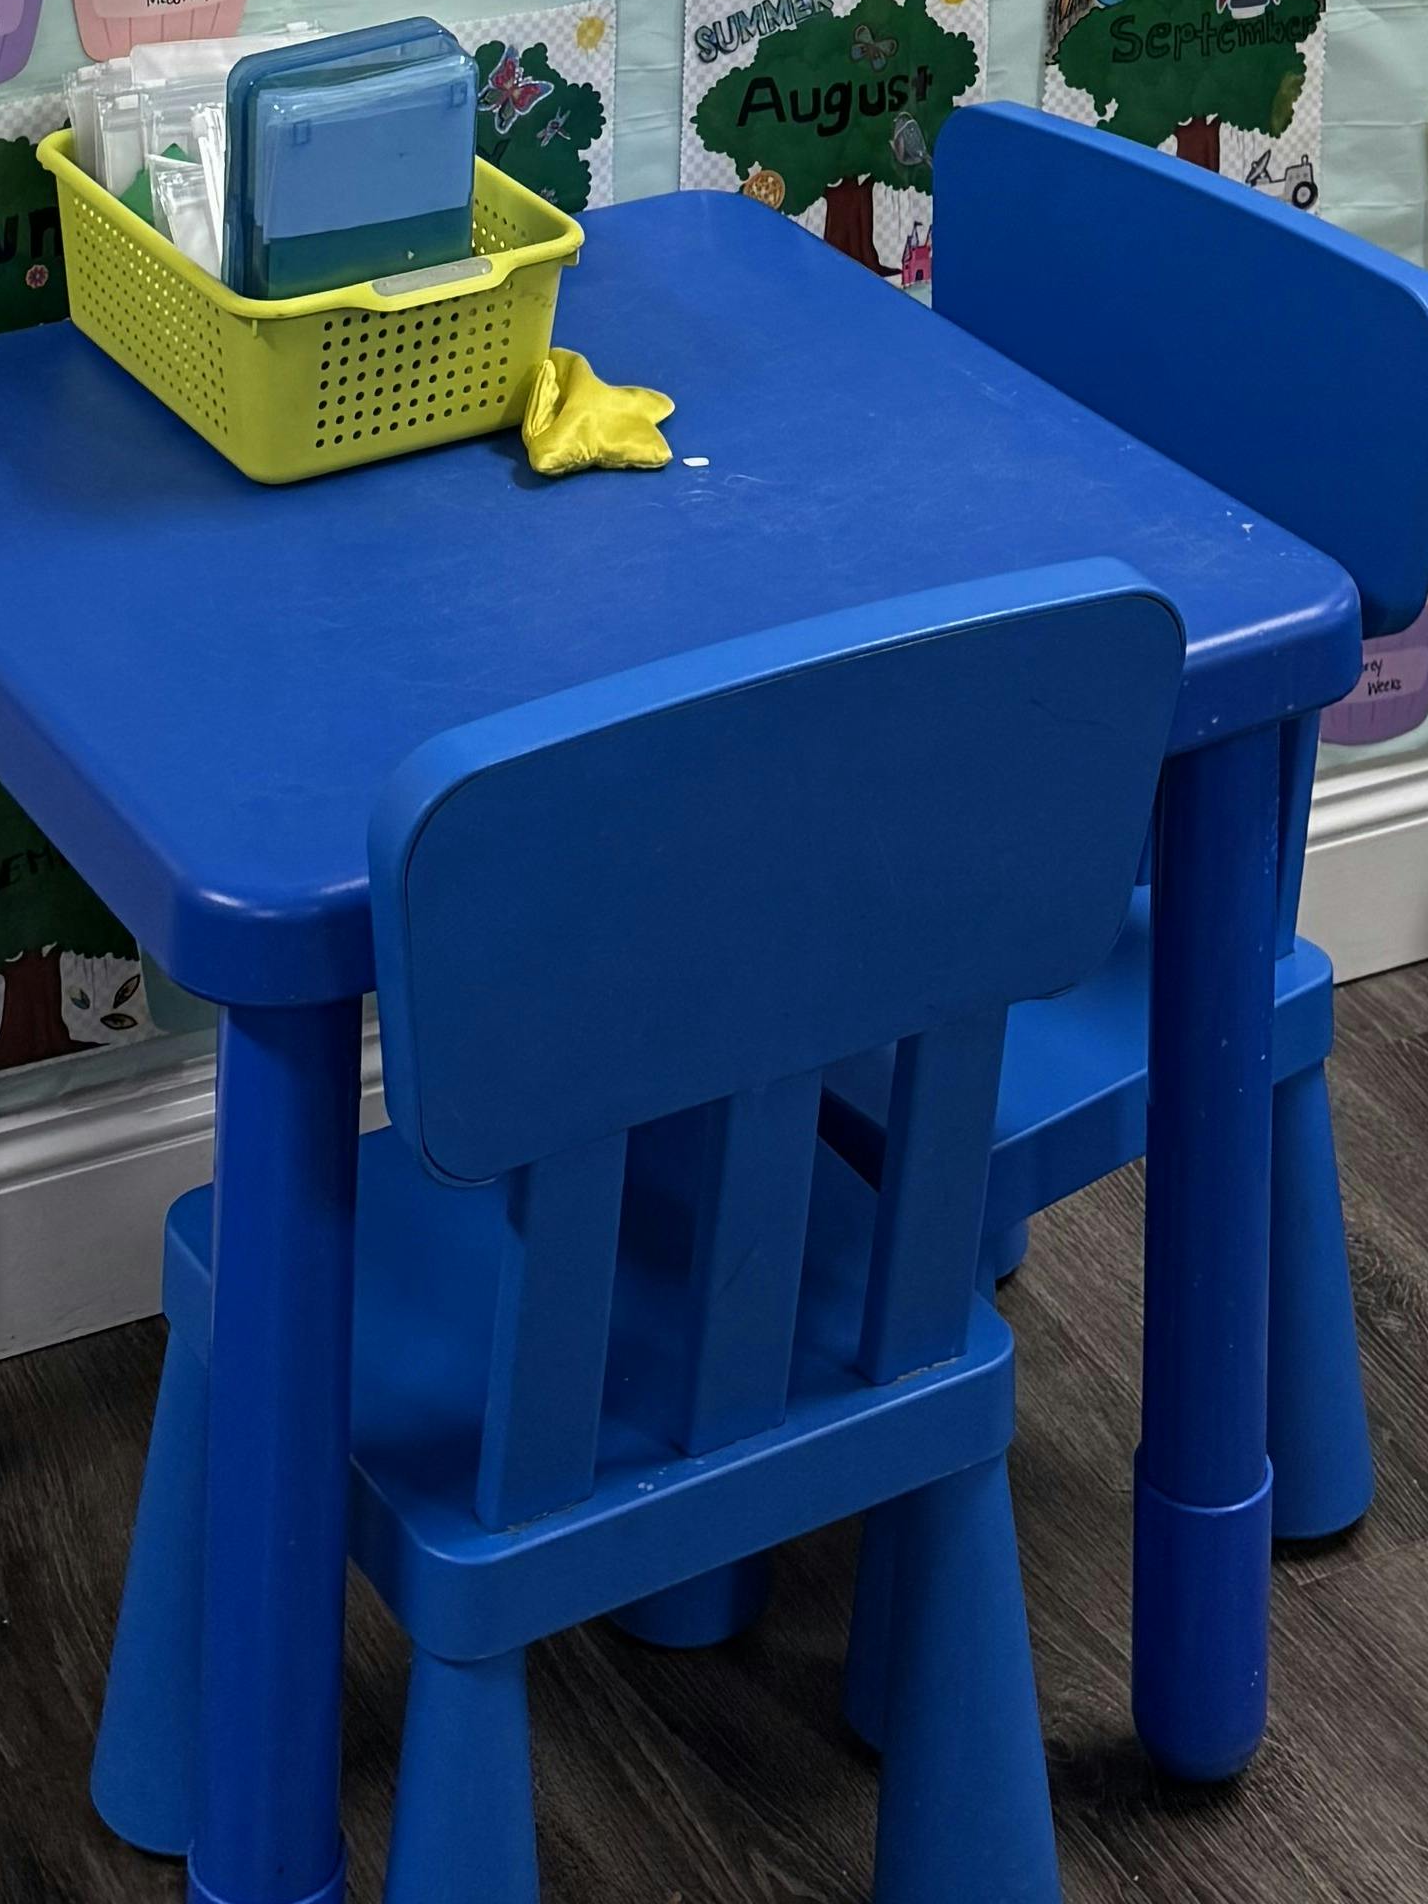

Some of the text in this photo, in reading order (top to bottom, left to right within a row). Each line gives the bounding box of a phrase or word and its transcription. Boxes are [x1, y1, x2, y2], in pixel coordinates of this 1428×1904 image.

[1110, 11, 1319, 63] September
[737, 65, 934, 137] August
[1368, 679, 1402, 696] Weeks
